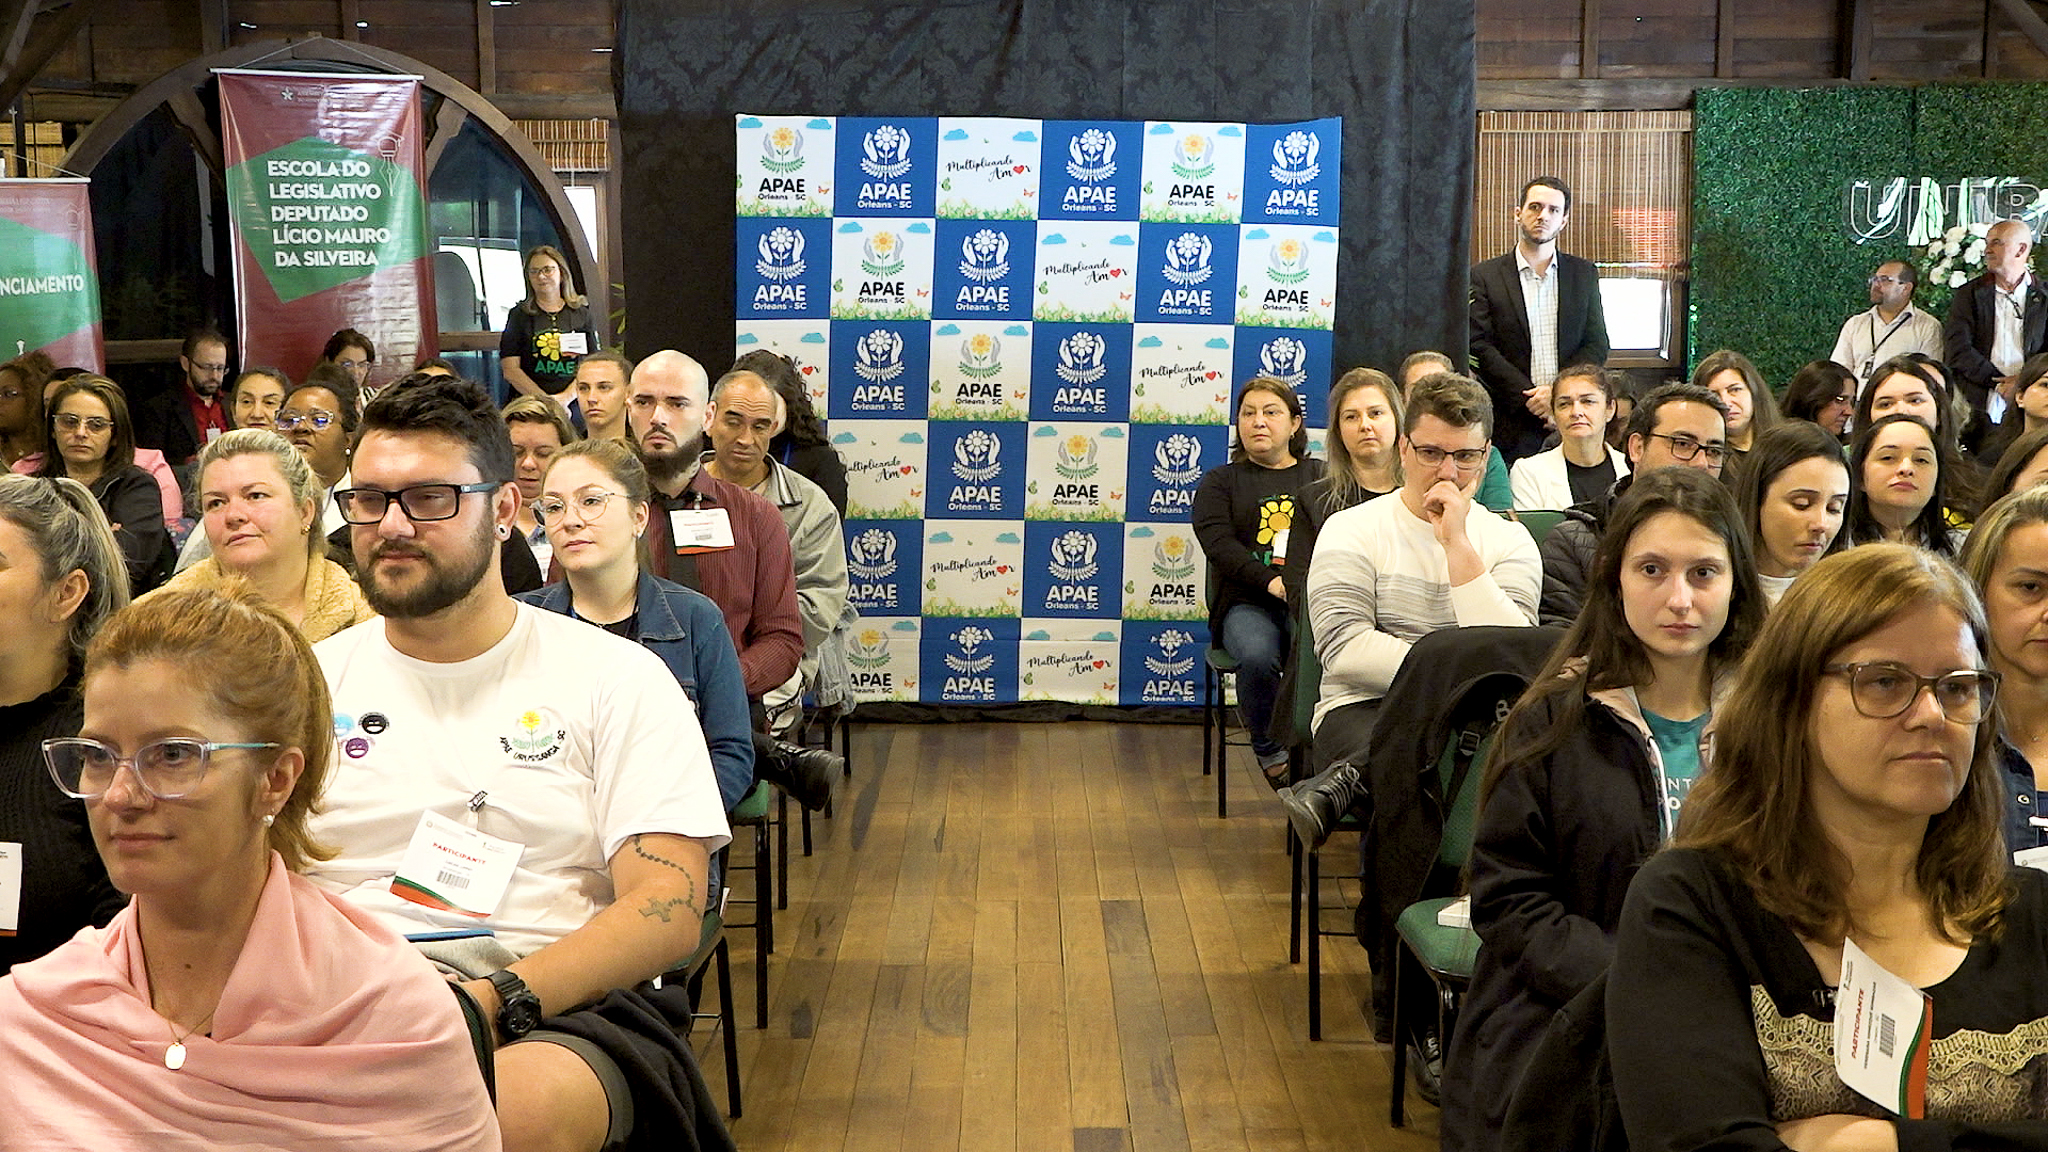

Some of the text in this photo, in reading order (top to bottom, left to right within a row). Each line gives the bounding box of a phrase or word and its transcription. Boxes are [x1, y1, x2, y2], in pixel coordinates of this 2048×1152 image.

[267, 161, 371, 177] ESCOLA DO
[946, 155, 1013, 172] Multiplicando
[269, 183, 382, 199] LEGISLATIVO
[759, 178, 805, 193] APAE
[859, 183, 912, 200] APAE
[1169, 185, 1215, 199] APAE
[1063, 186, 1116, 203] APAE
[1266, 190, 1319, 207] APAE
[858, 200, 891, 209] Orleans
[899, 201, 912, 209] SC
[1062, 203, 1097, 212] Orleans
[1104, 204, 1117, 212] SC
[1265, 207, 1300, 215] Orleans
[1306, 208, 1319, 216] SC
[271, 206, 369, 222] DEPUTADO
[273, 224, 391, 244] LÍCIO MAURO
[274, 250, 379, 267] DA SILVEIRA
[1043, 258, 1110, 276] Multiplicando
[0, 274, 84, 295] NCIAMENTO
[859, 282, 905, 296] APAE
[755, 284, 806, 302] APAE
[957, 286, 1009, 303] APAE
[1159, 289, 1212, 306] APAE
[1263, 289, 1309, 304] APAE
[753, 302, 787, 310] Orleans
[794, 302, 807, 310] SC
[956, 303, 990, 311] Orleans
[996, 303, 1010, 312] SC
[1158, 306, 1192, 315] Orleans
[1199, 307, 1212, 315] SC
[534, 360, 576, 374] APAE
[1139, 361, 1206, 379] Multiplicando
[852, 385, 905, 403] APAE
[957, 383, 1002, 398] APAE
[1054, 388, 1106, 405] APAE
[892, 403, 905, 411] SC
[1053, 405, 1086, 413] Orleans
[1093, 405, 1106, 413] SC
[950, 486, 1001, 503] APAE
[1053, 484, 1099, 498] APAE
[948, 503, 982, 511] Orleans
[989, 503, 1002, 511] SC
[1149, 506, 1183, 514] Orleans
[931, 555, 997, 573] Multiplicando
[848, 584, 897, 600] APAE
[1046, 585, 1099, 602] APAE
[1150, 584, 1195, 598] APAE
[886, 600, 898, 608] SC
[1045, 602, 1078, 610] Orleans
[1086, 602, 1099, 610] SC
[1027, 651, 1093, 668] Multiplicando
[944, 677, 994, 693] APAE
[1143, 680, 1195, 695] APAE
[1668, 778, 1692, 791] NT
[1851, 988, 1865, 1059] PARTICIPANTE
